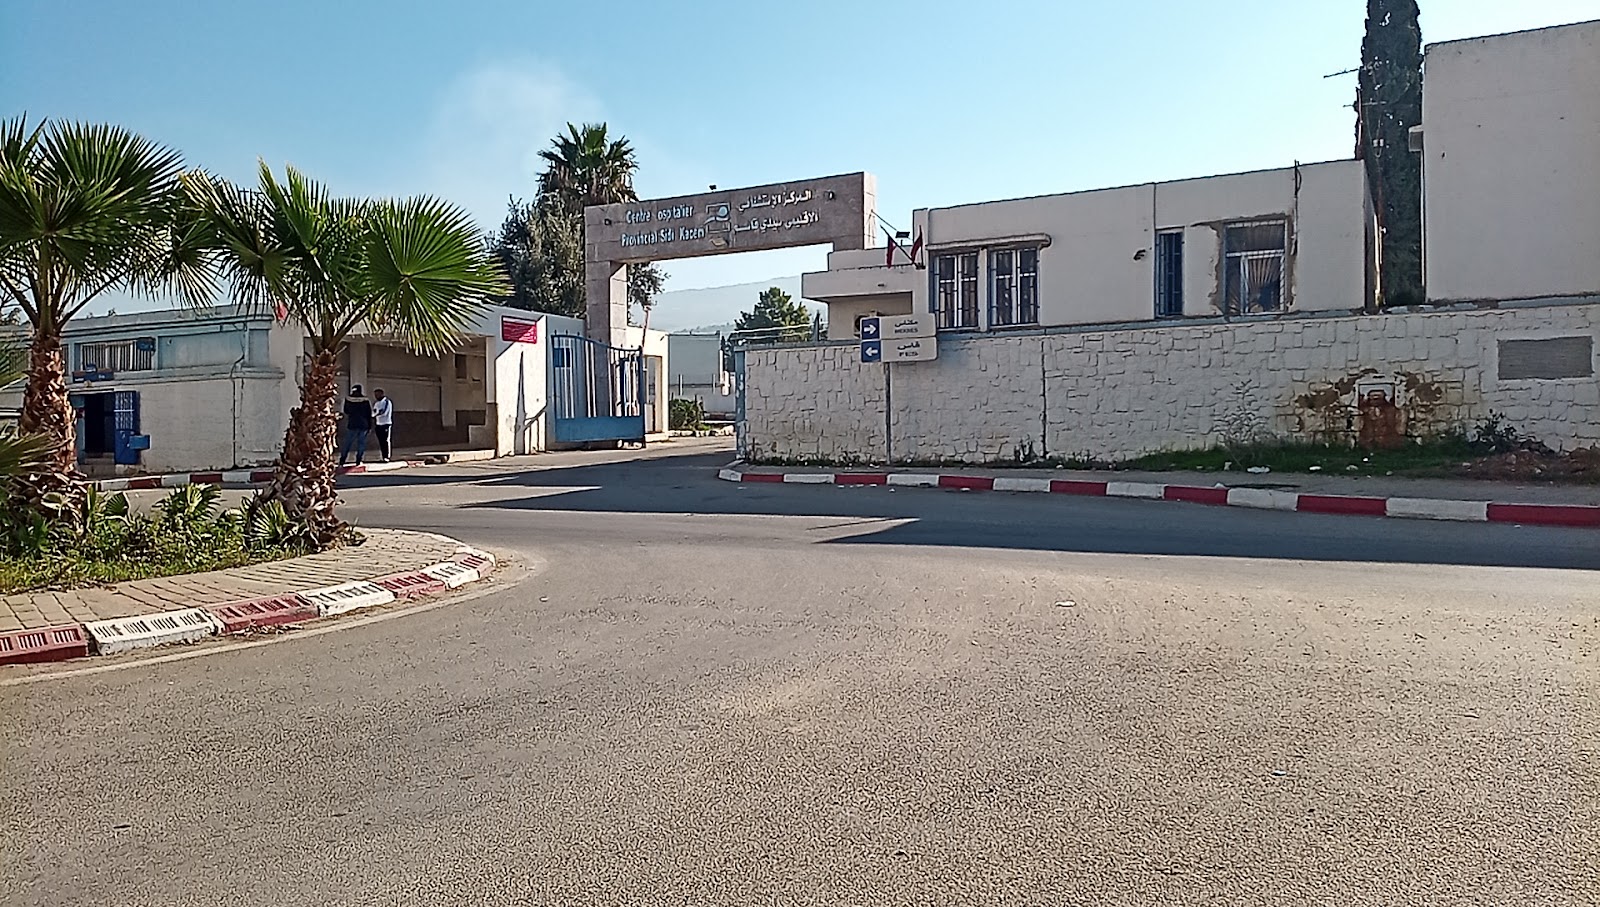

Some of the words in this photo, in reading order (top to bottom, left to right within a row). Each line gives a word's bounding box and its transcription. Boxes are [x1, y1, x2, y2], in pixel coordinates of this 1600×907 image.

[783, 190, 812, 207] المركز
[626, 208, 651, 224] Centre
[621, 231, 658, 247] Provincial
[660, 228, 675, 242] Sidi
[679, 227, 705, 241] Kacem
